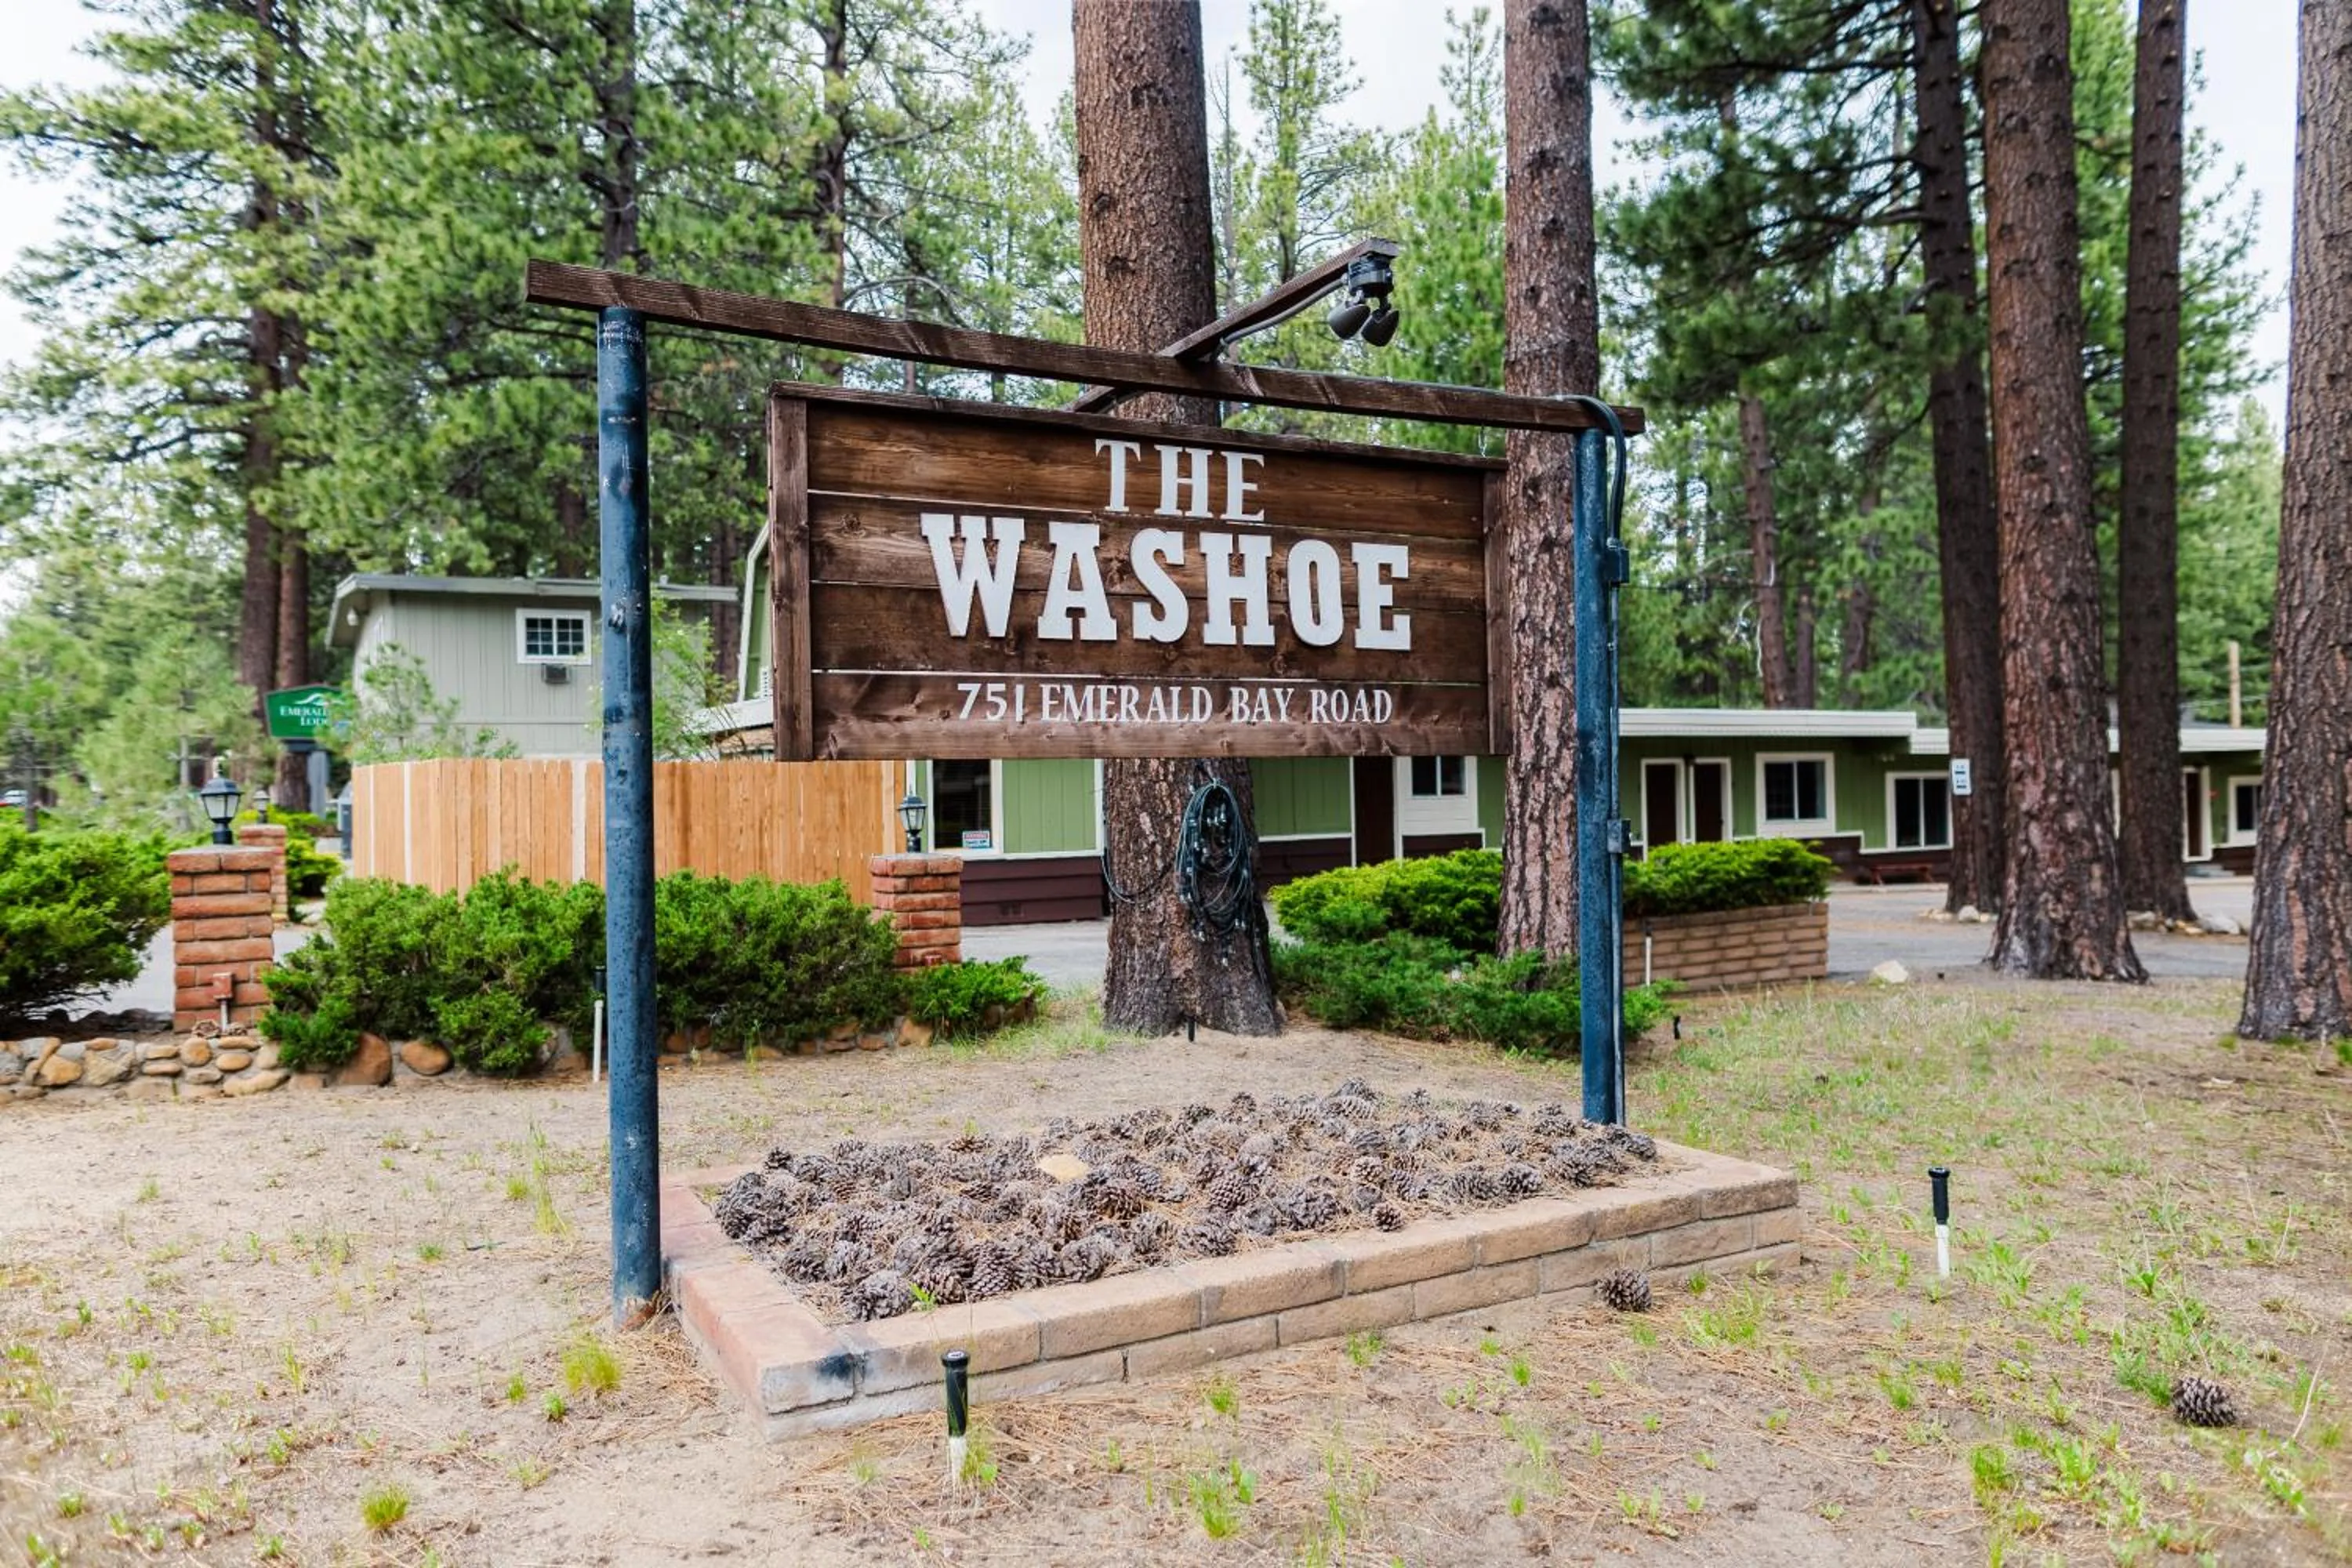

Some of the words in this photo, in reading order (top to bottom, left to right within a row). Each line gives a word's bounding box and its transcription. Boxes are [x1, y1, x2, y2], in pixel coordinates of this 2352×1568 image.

[1095, 438, 1265, 521] THE
[920, 513, 1412, 651] WASHOE
[957, 682, 1025, 723] 751
[1039, 683, 1214, 724] EMERALD
[1229, 687, 1295, 724] BAY
[1308, 688, 1393, 724] ROAD
